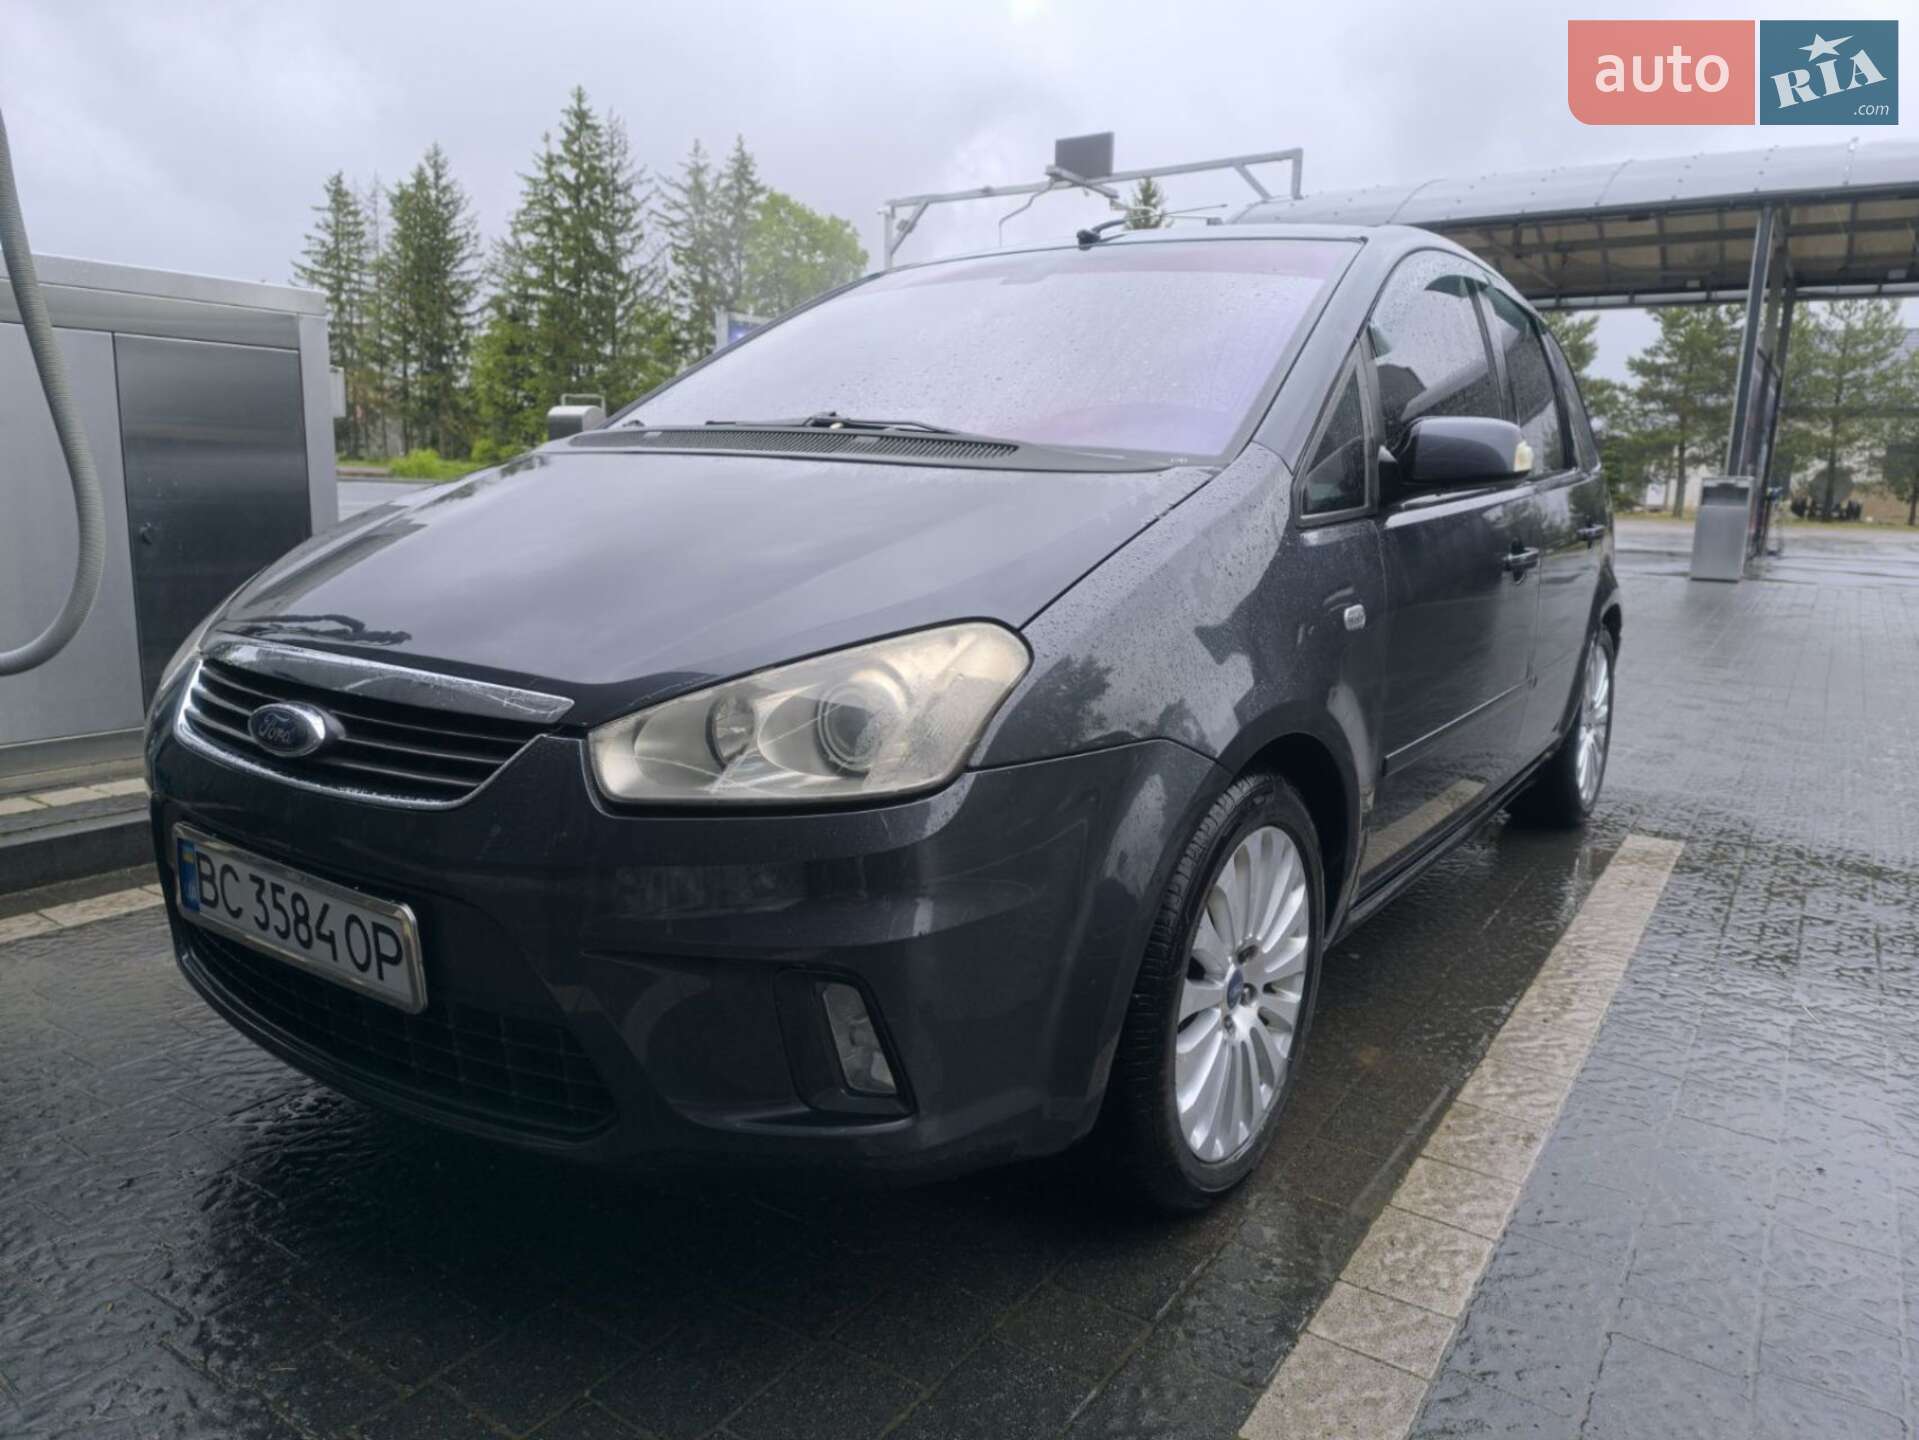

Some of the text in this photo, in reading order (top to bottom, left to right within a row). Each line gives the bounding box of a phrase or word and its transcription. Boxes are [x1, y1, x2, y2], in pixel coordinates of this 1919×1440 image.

[196, 851, 403, 981] BC 3584 OP
